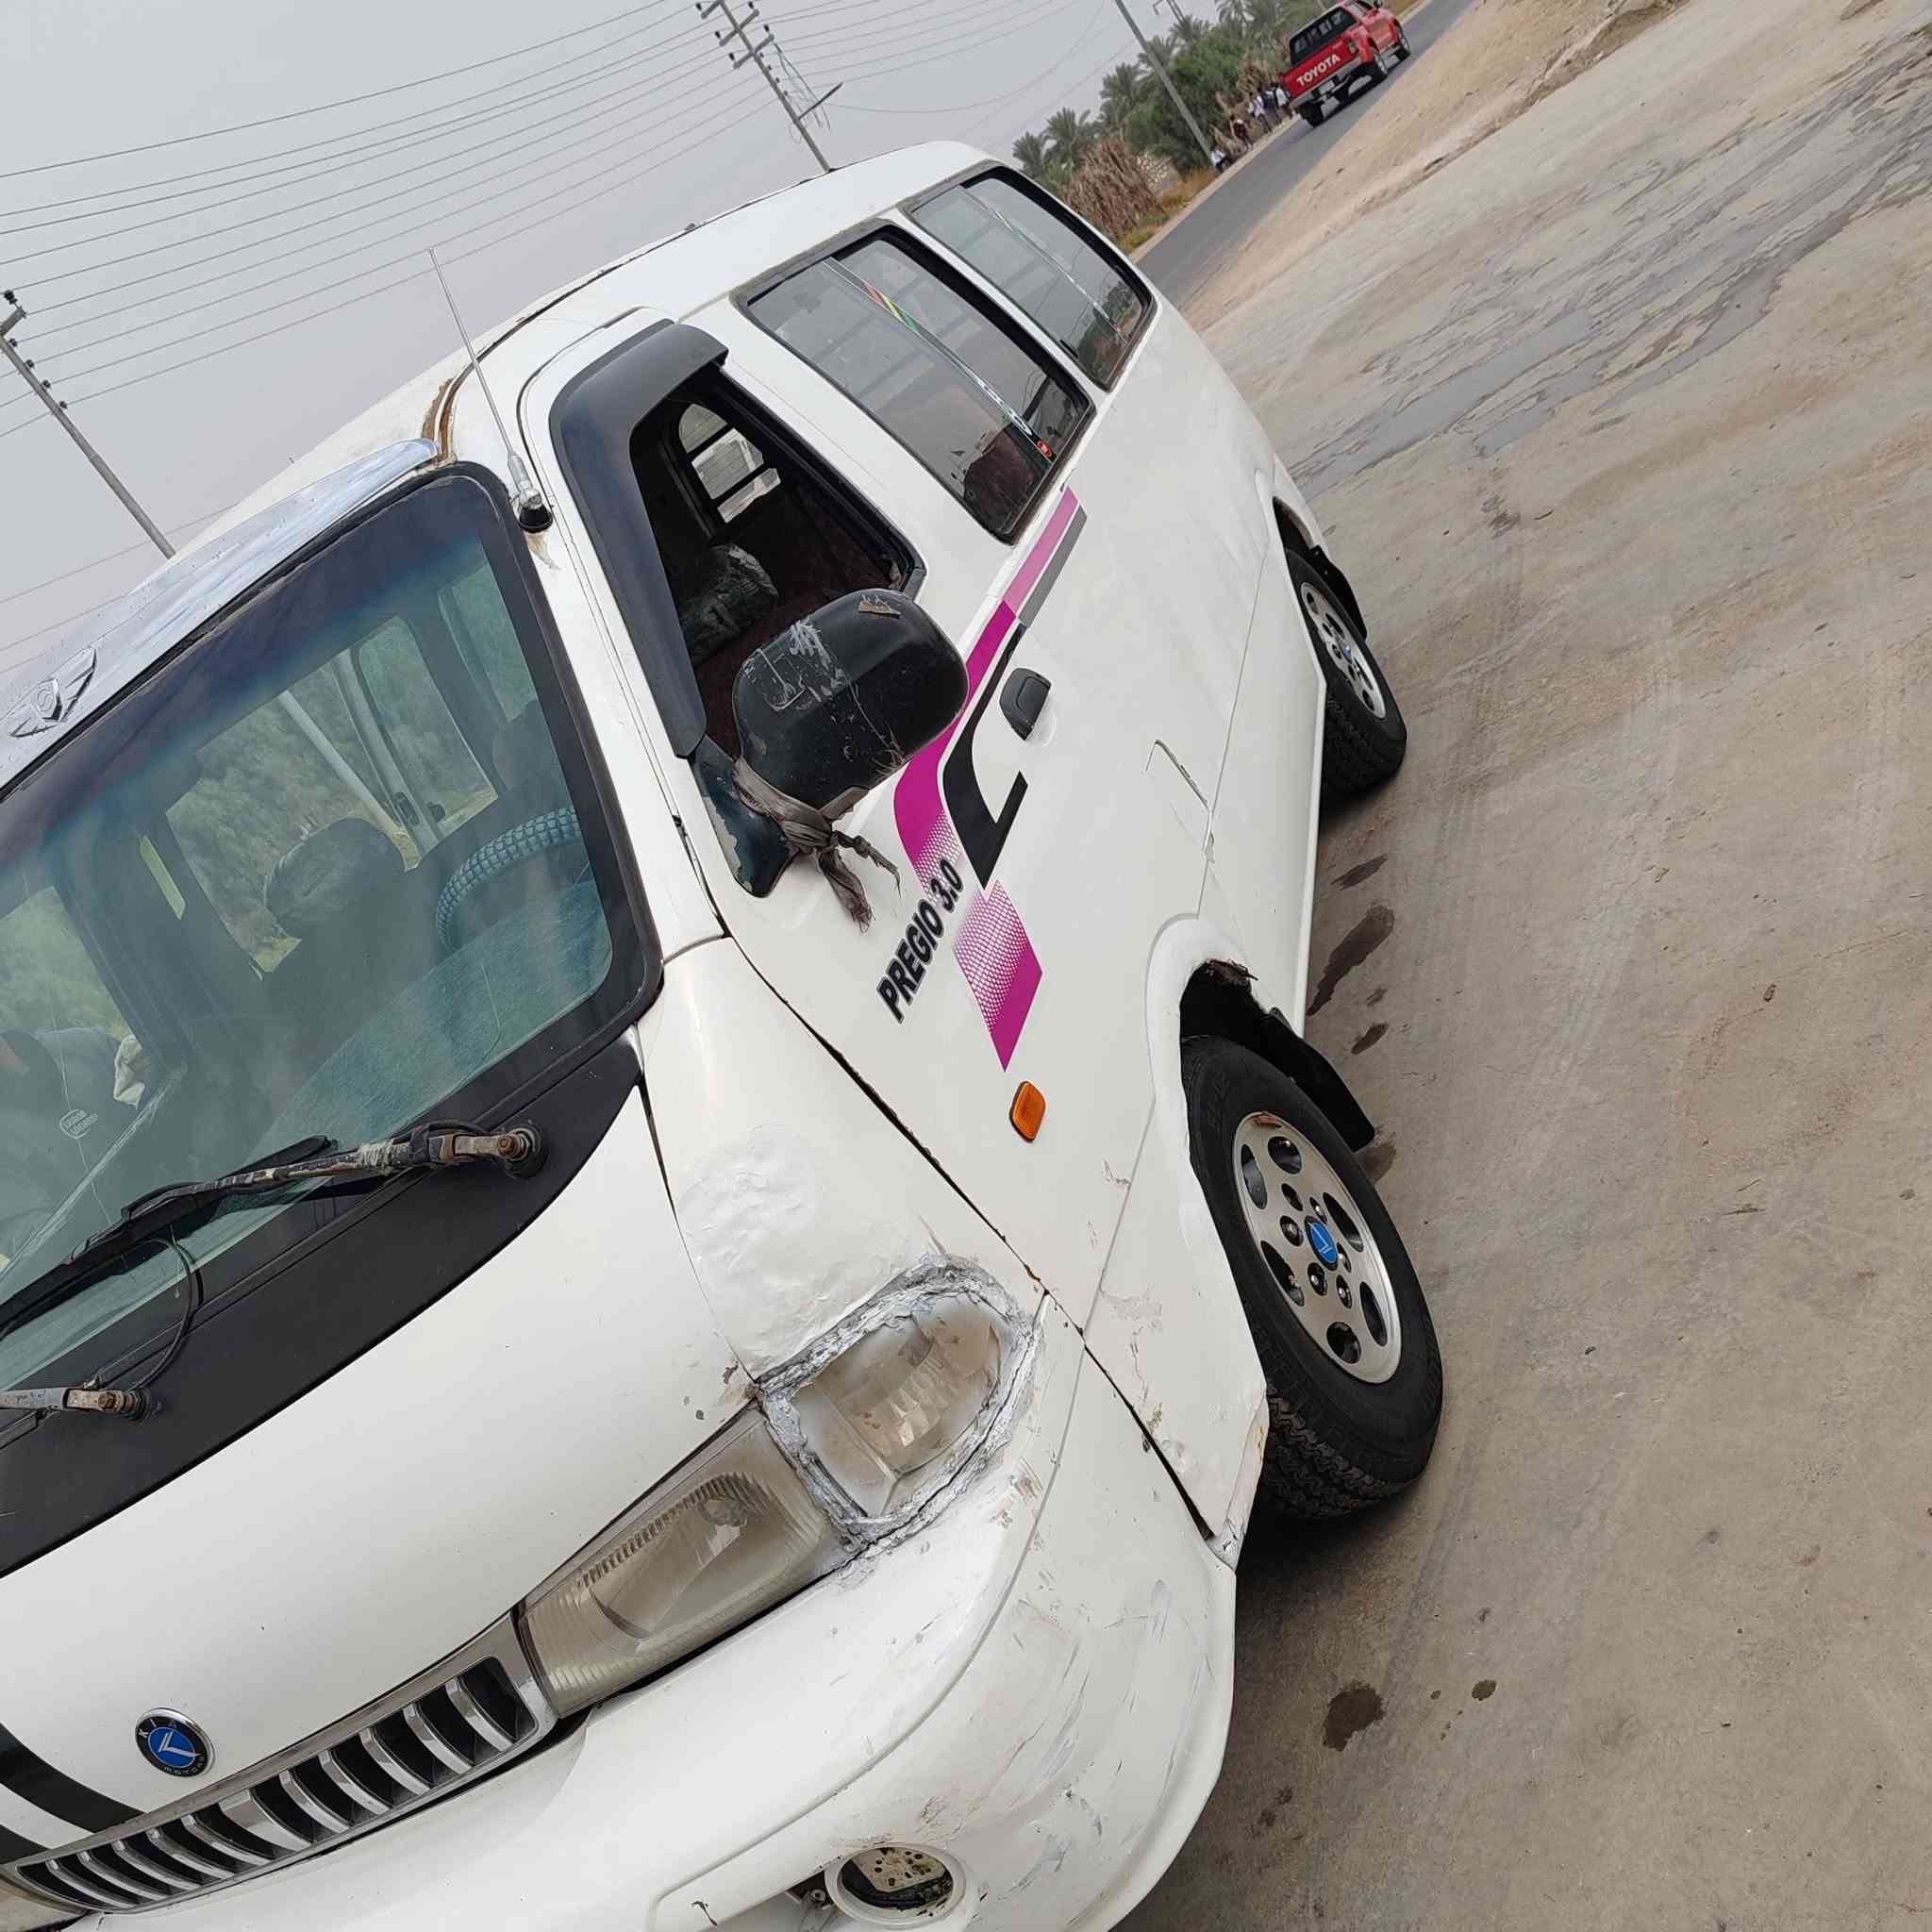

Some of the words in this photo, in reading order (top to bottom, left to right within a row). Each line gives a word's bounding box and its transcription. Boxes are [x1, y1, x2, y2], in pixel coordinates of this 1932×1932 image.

[1296, 53, 1341, 86] TOYOTA
[875, 898, 943, 1024] PREGIO
[930, 858, 963, 914] 3.0
